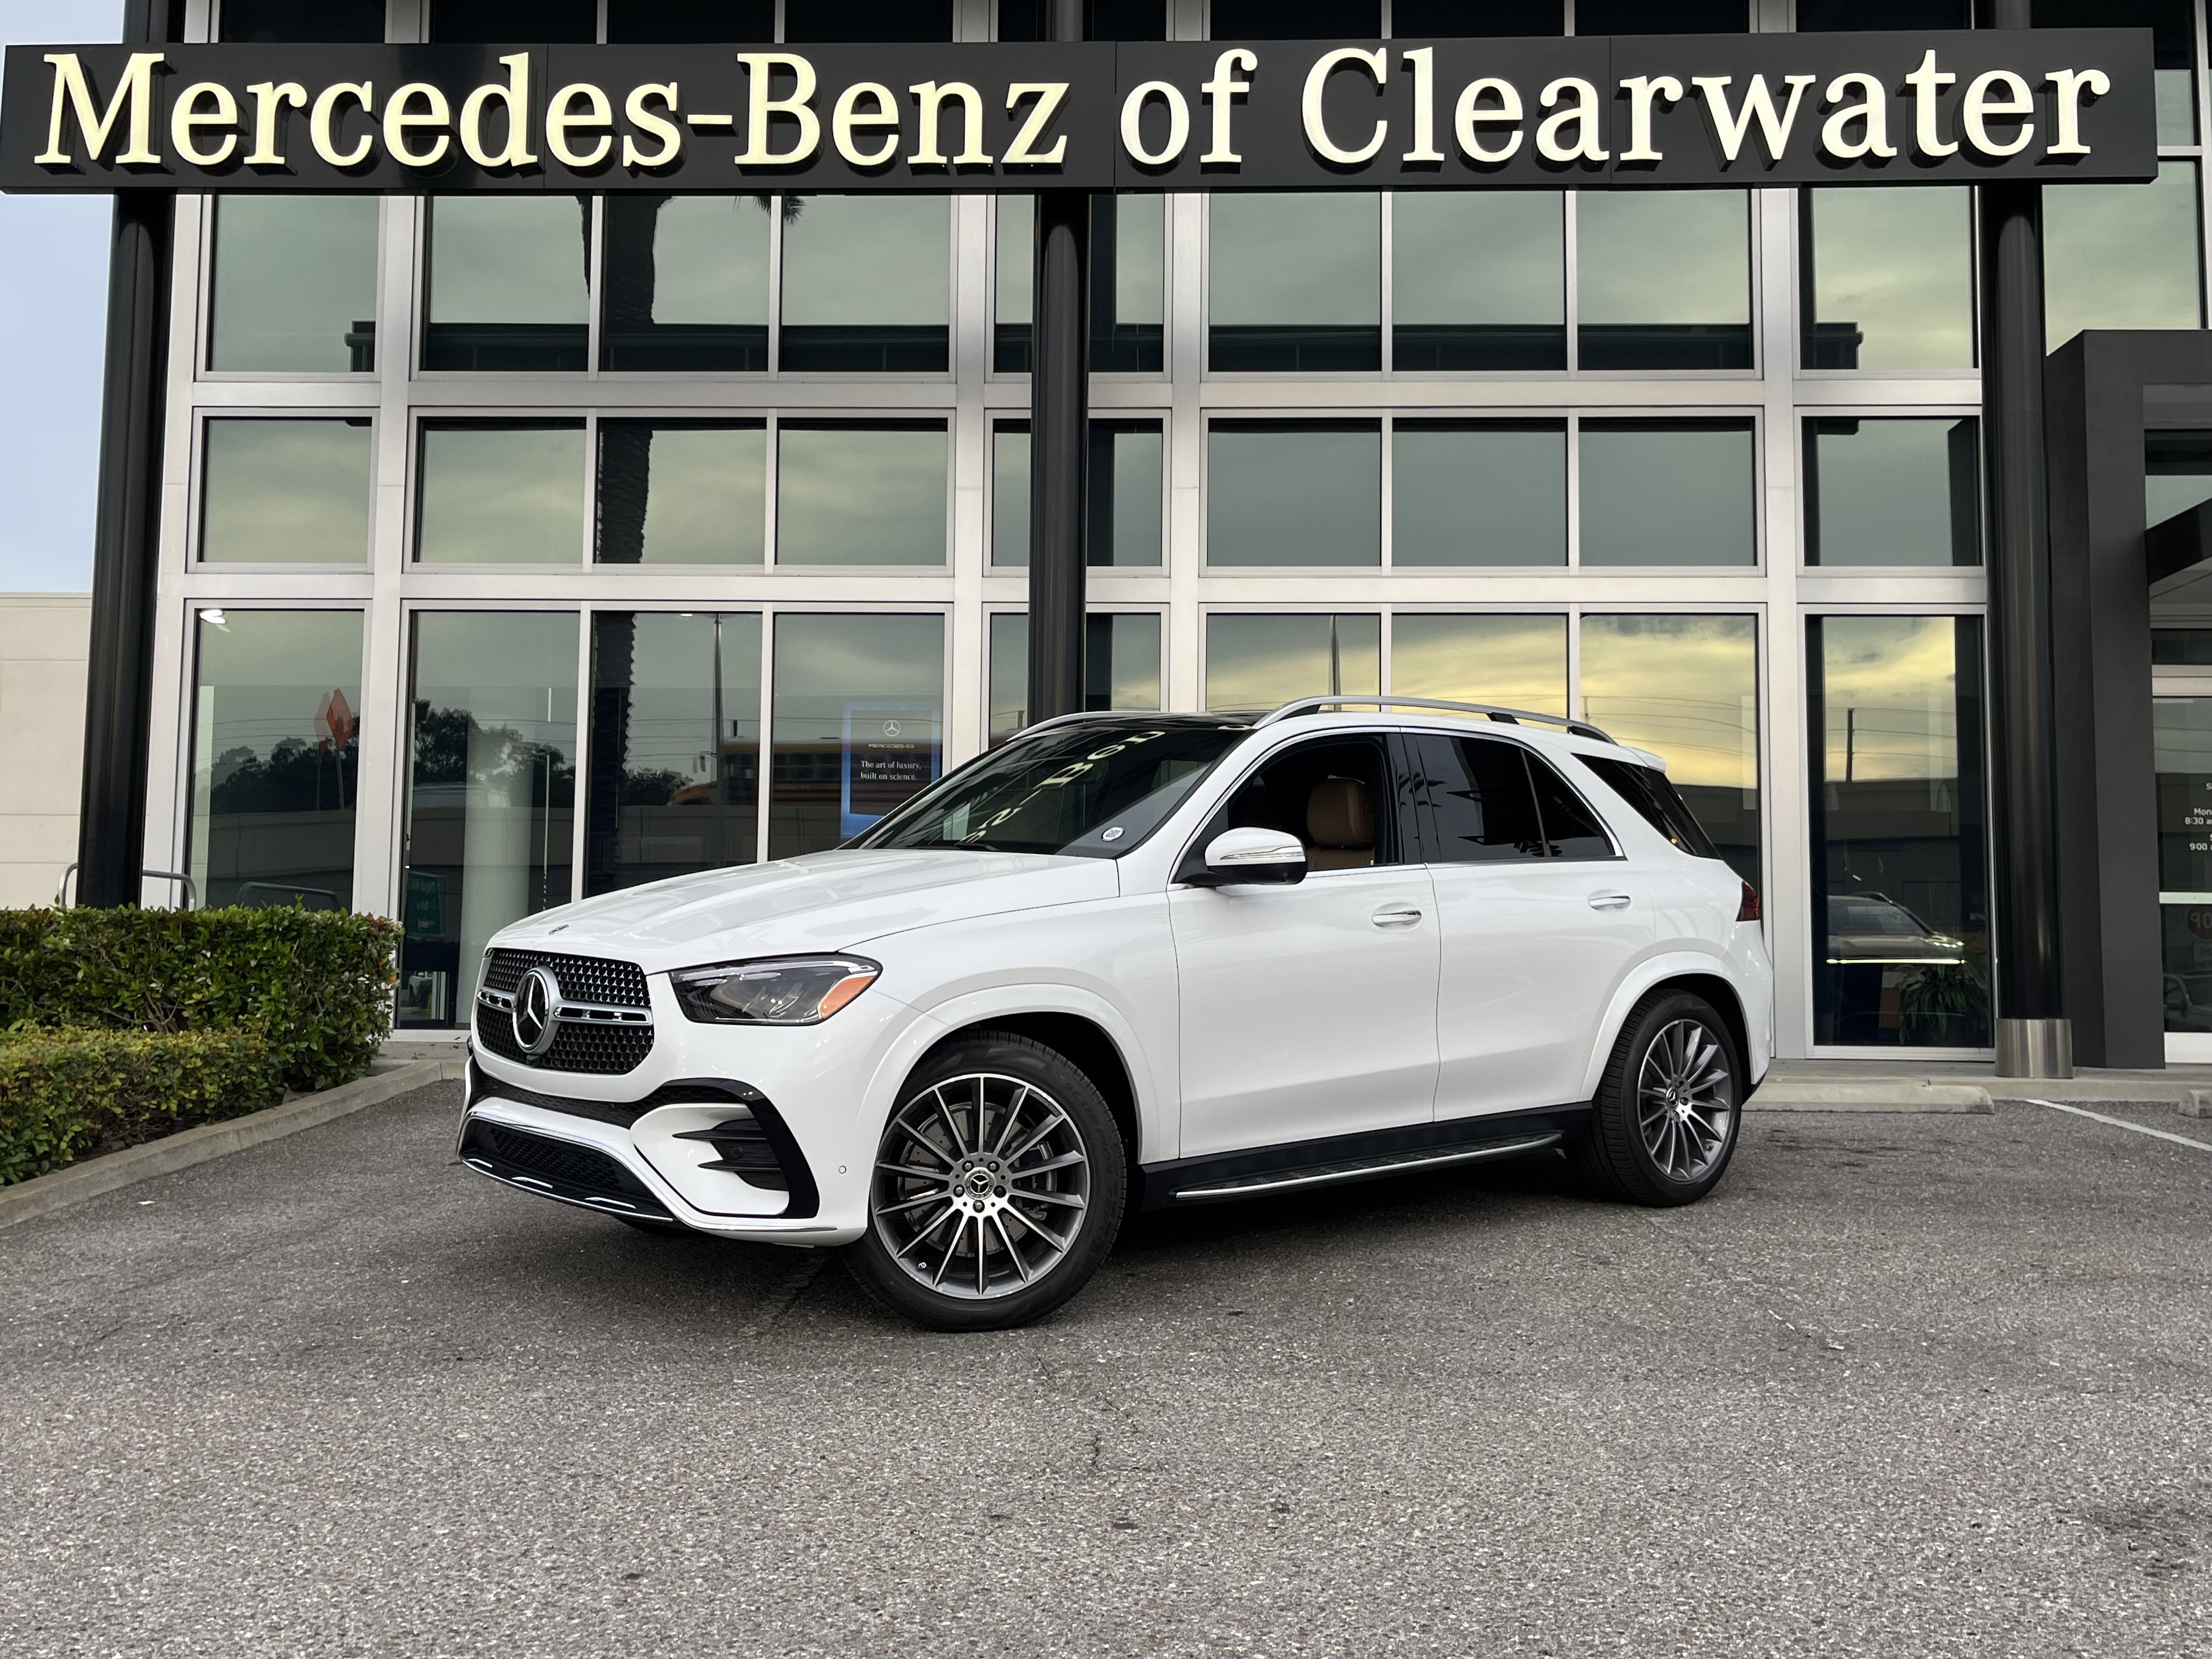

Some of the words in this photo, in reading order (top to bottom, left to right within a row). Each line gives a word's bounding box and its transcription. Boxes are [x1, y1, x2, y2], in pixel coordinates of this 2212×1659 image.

[35, 53, 1069, 166] Mercedes-Benz
[1121, 49, 1257, 163] of
[1303, 47, 2109, 162] Clearwater
[896, 761, 922, 771] luxury,
[2194, 808, 2212, 816] Mon
[2185, 817, 2204, 825] 8:30
